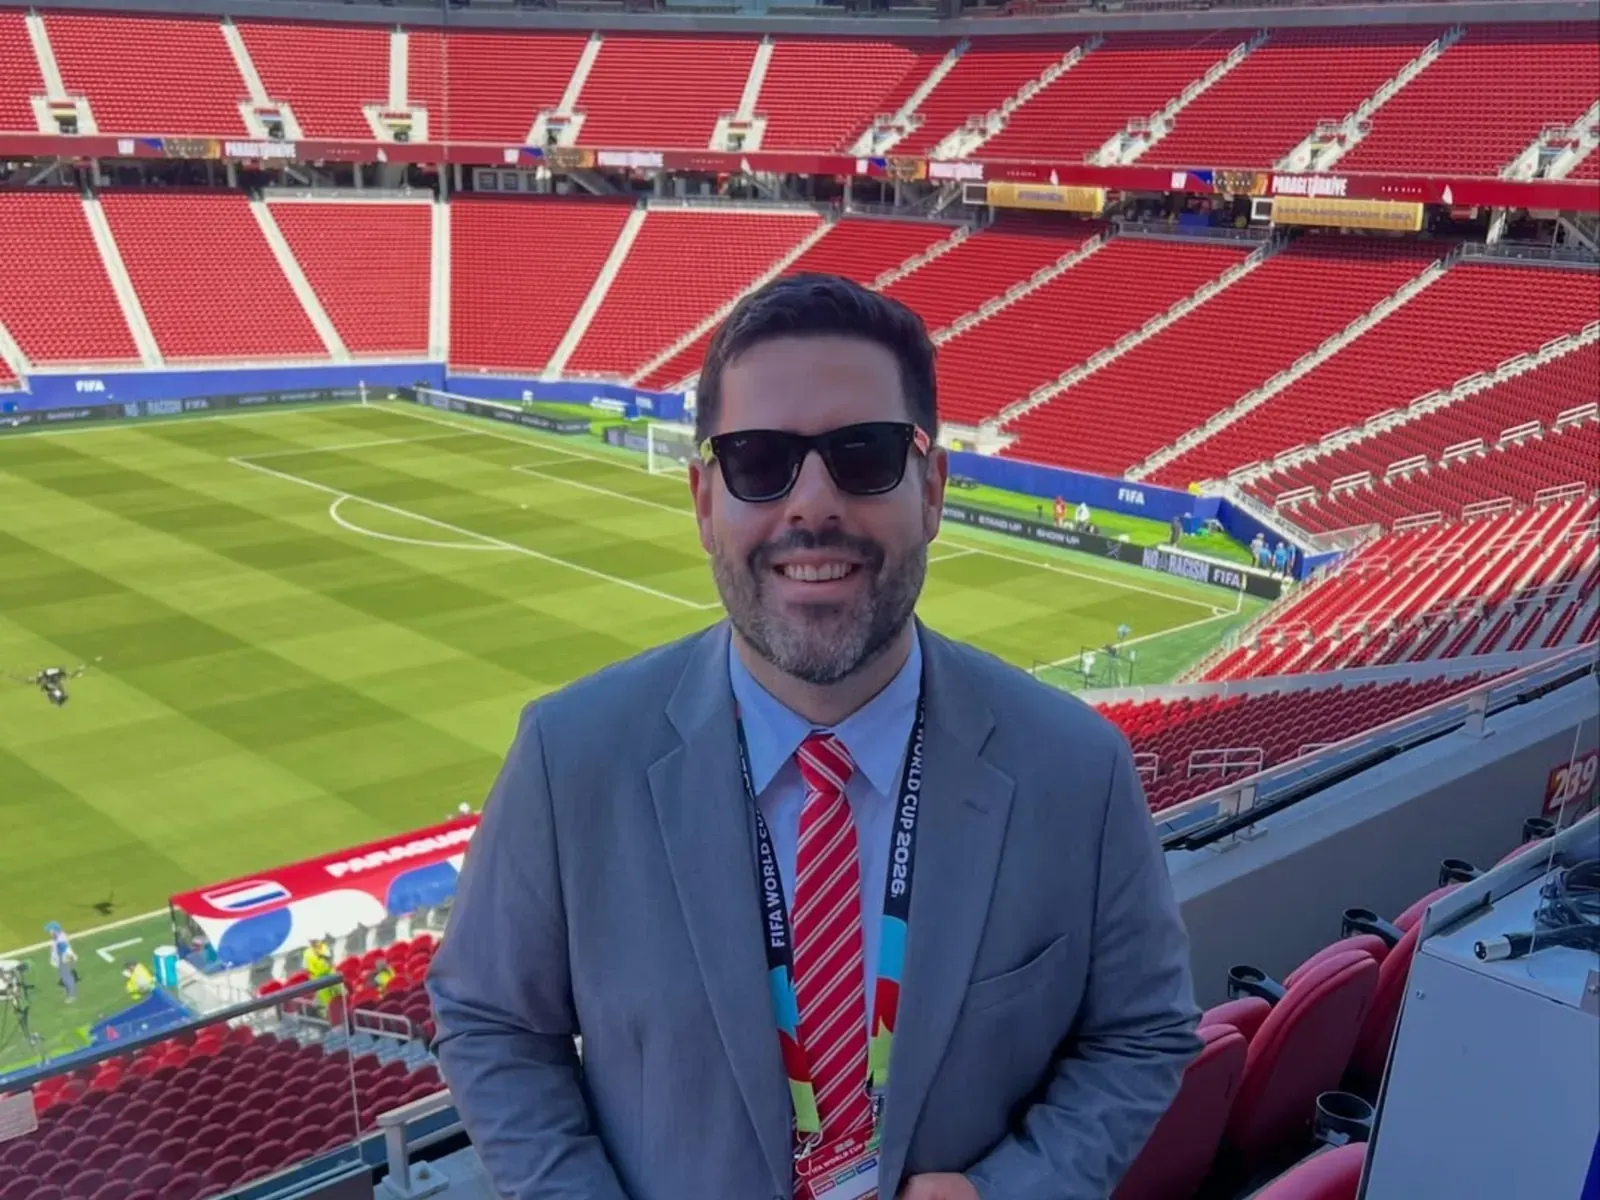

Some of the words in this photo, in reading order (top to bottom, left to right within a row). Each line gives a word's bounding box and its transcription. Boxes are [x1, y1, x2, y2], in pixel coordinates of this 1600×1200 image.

[75, 380, 105, 392] FIFA
[1117, 487, 1146, 506] FIFA
[1213, 569, 1242, 589] FIFA
[1548, 754, 1598, 809] 239
[900, 793, 918, 830] CUP
[760, 842, 782, 908] WORLD
[769, 908, 786, 948] FIFA
